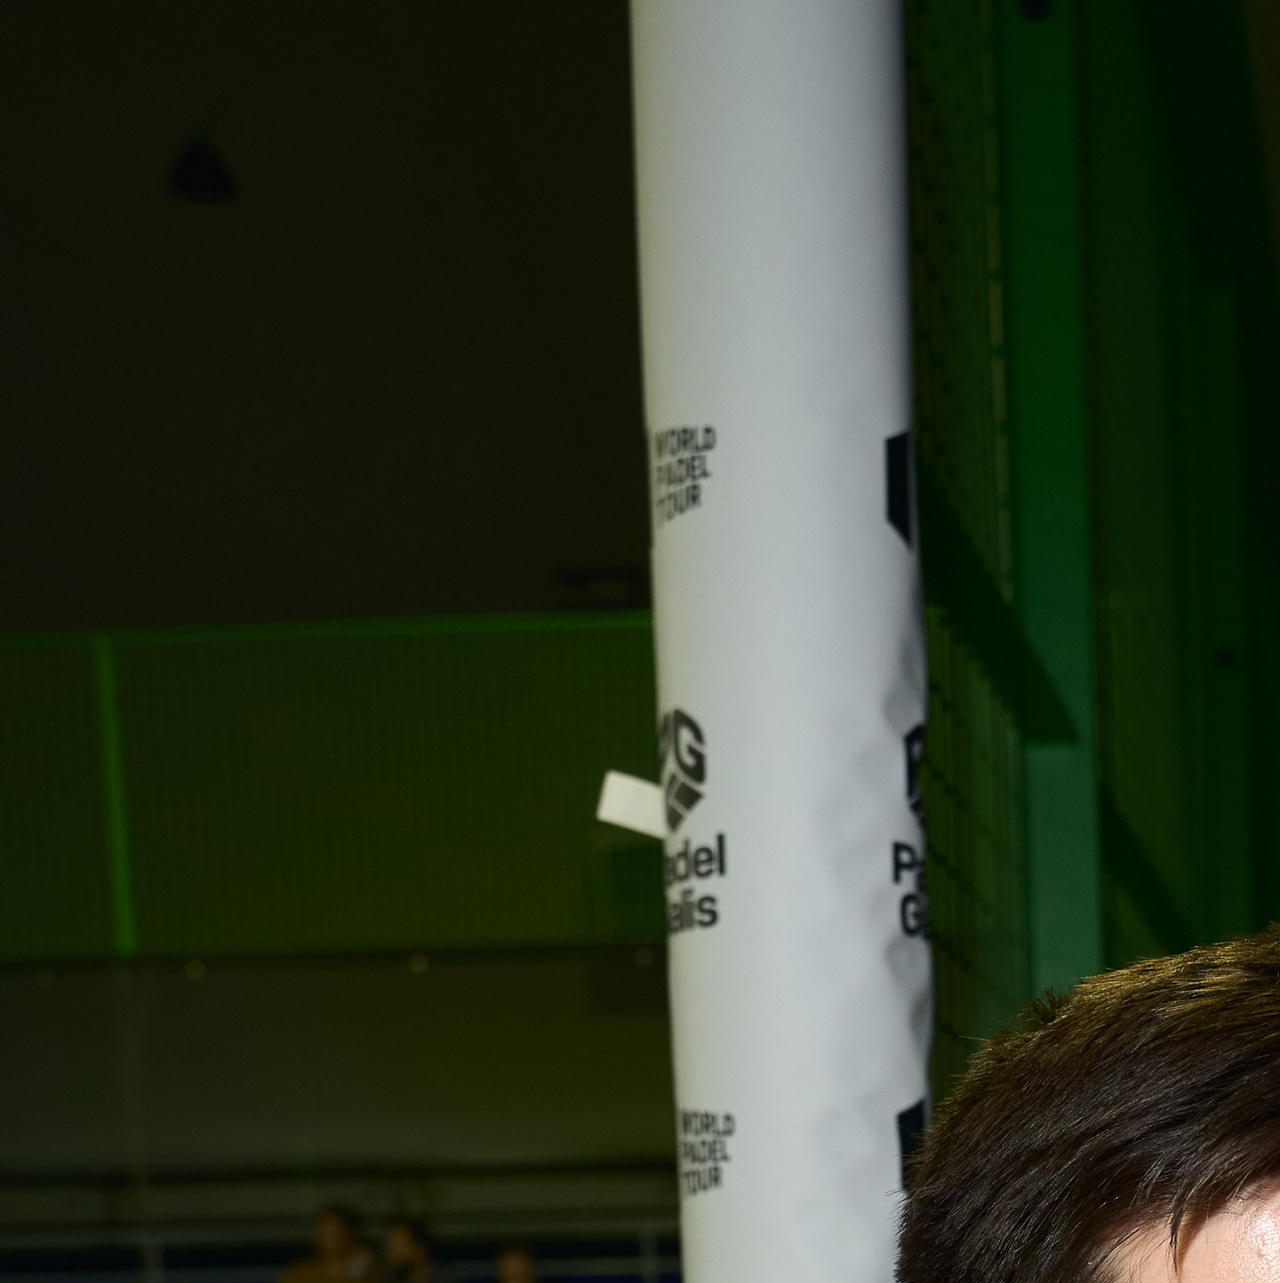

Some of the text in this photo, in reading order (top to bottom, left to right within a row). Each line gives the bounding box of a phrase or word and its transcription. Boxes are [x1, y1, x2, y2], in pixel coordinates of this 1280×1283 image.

[655, 427, 717, 457] WORLD
[656, 454, 711, 486] PADEL
[656, 484, 702, 525] TOUR
[666, 832, 726, 886] adel
[668, 888, 718, 935] alis
[681, 1110, 735, 1137] WORLD
[682, 1138, 731, 1164] PADEL
[682, 1167, 722, 1195] TOUR
